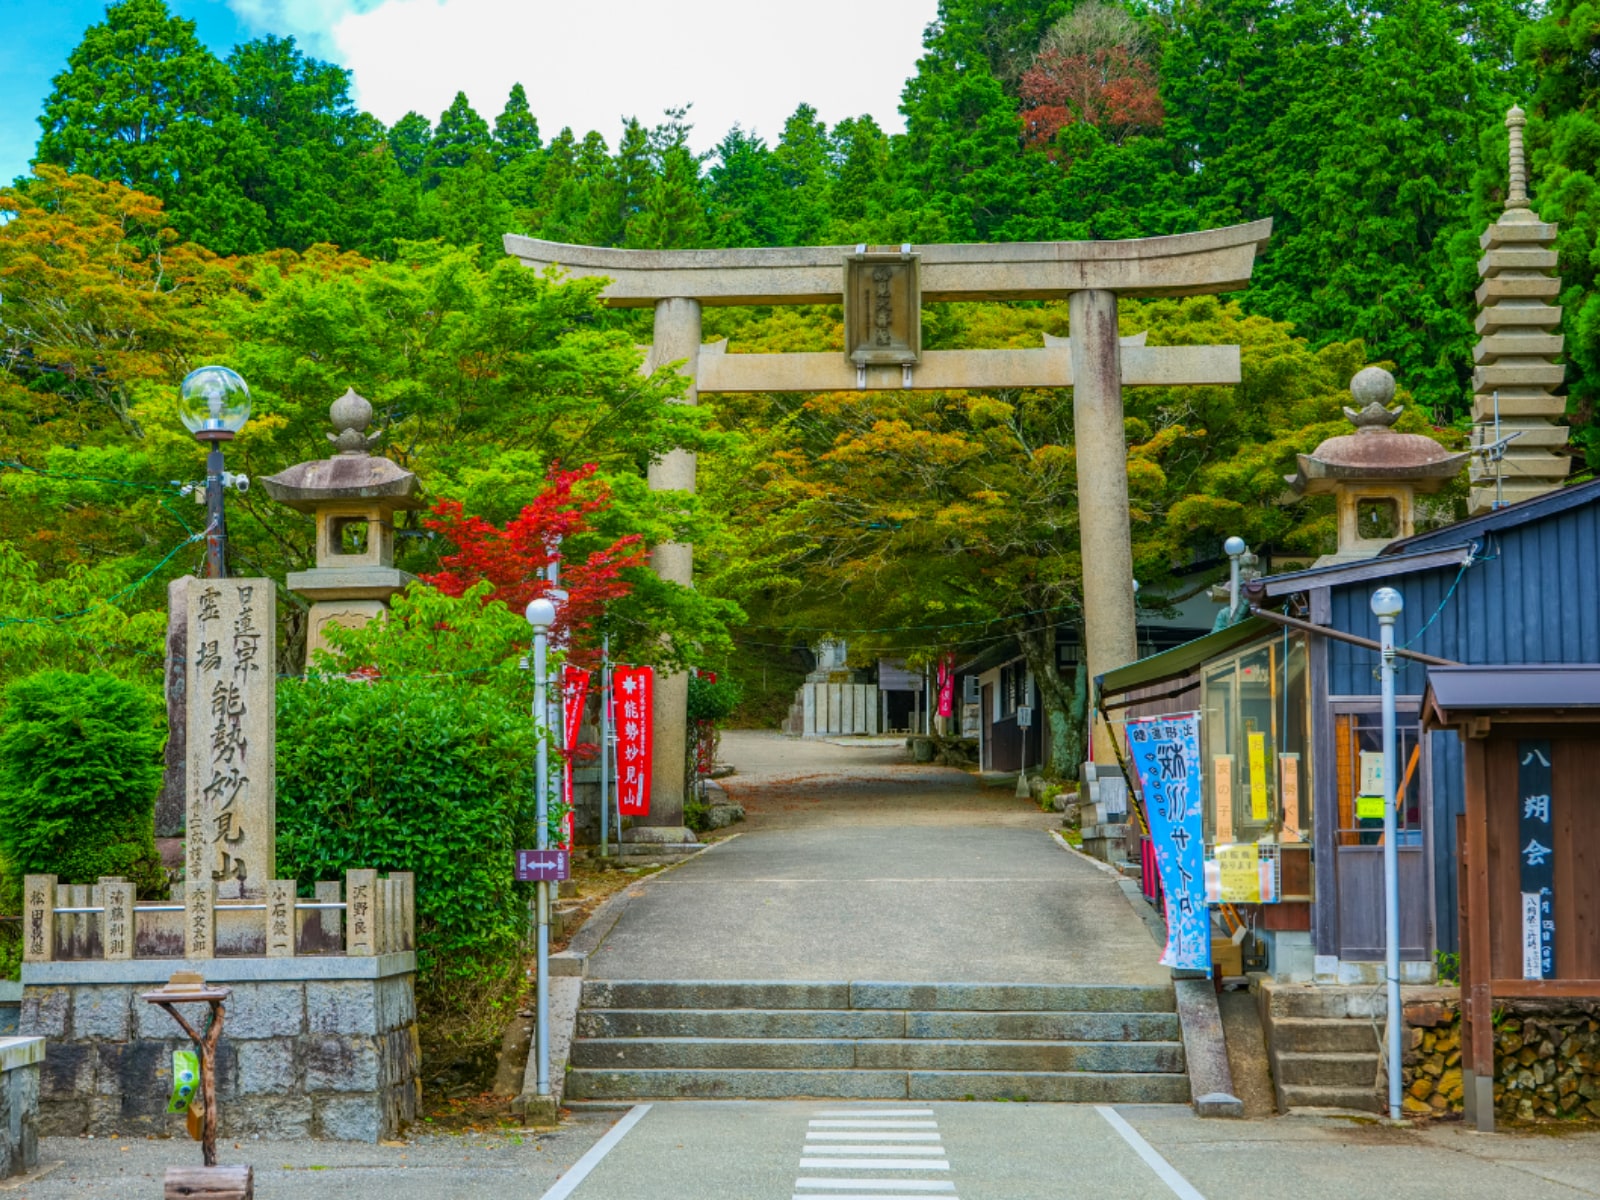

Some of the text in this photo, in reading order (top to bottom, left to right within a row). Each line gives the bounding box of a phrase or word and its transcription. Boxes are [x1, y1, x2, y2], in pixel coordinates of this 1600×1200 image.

[233, 585, 262, 675] 日蓮宗
[203, 680, 250, 882] 能勢妙見山
[622, 699, 640, 806] 能勢妙見山
[1522, 749, 1552, 866] 八朔会
